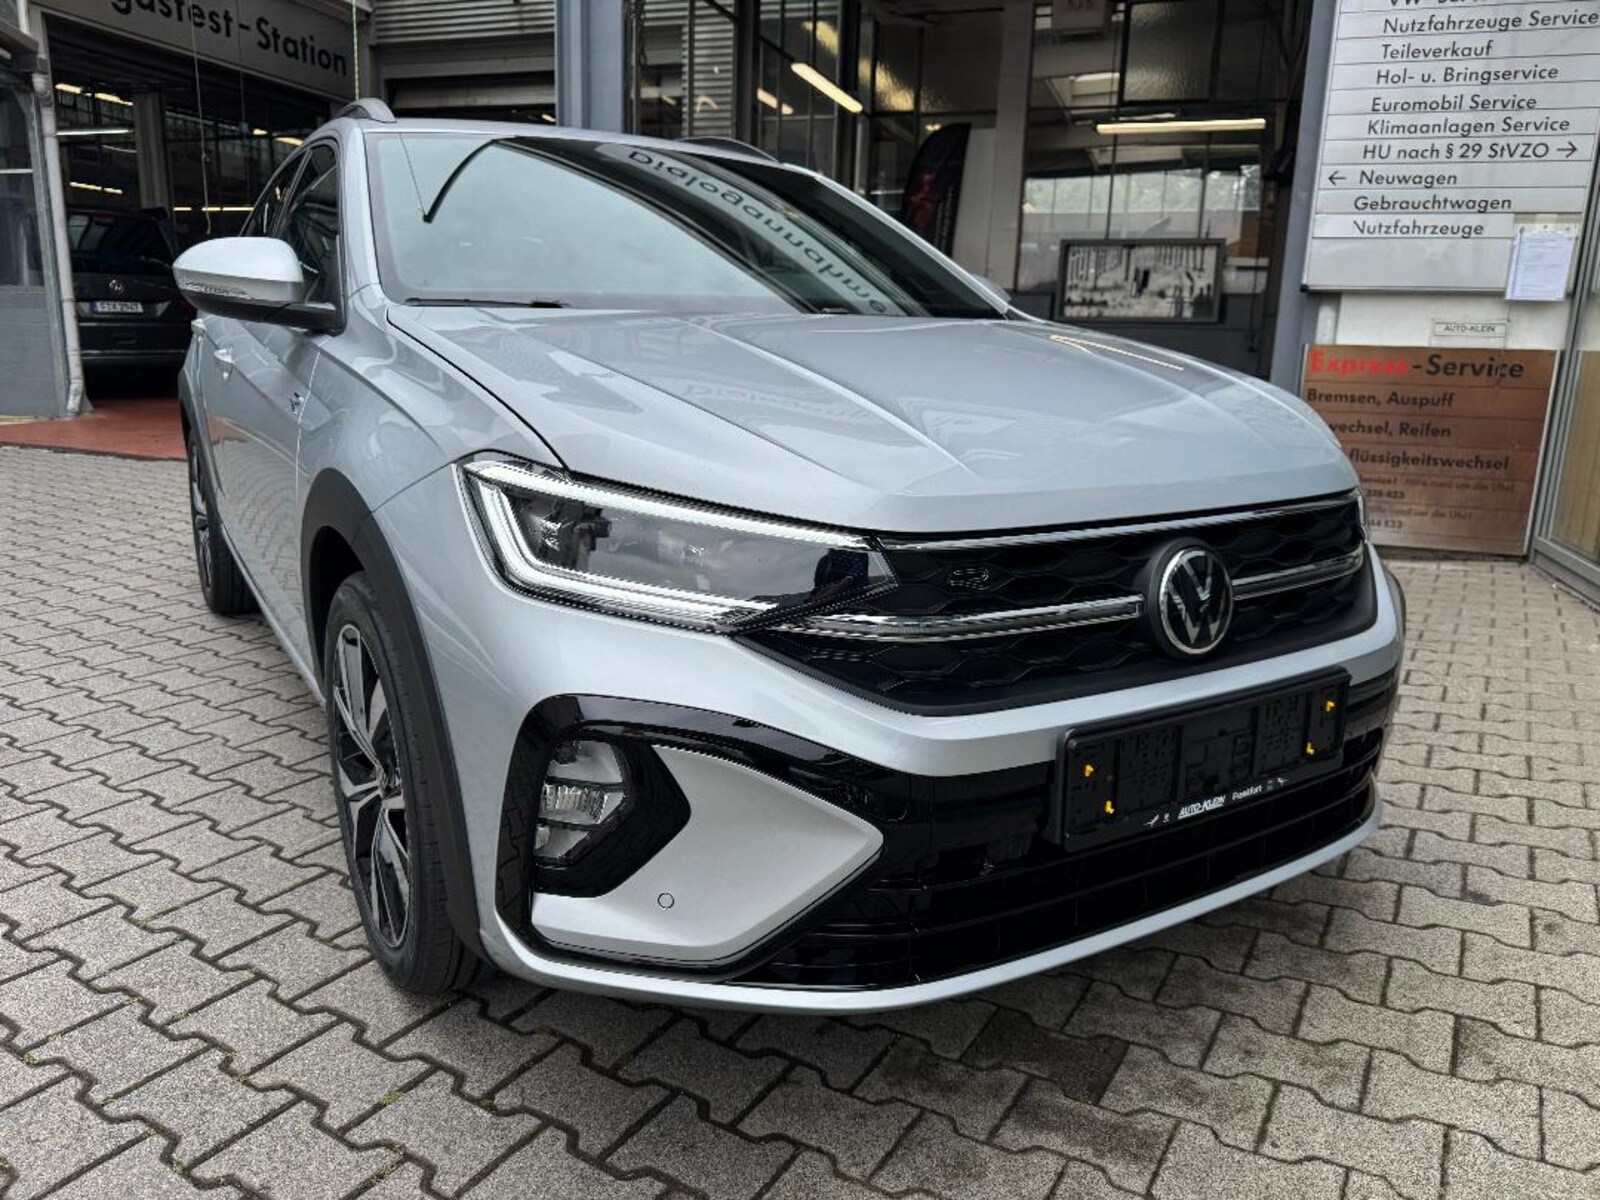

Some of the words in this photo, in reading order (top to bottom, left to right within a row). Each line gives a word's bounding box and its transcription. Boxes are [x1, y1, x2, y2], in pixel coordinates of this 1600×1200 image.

[1383, 13, 1522, 34] Nutzfahrzeuge
[1528, 10, 1599, 27] Service
[1382, 39, 1494, 60] Teileverkauf
[1376, 69, 1415, 84] Hol-
[1421, 72, 1436, 83] u.
[1443, 64, 1559, 85] Bringservice
[1371, 95, 1463, 112] Euromobil
[1469, 94, 1537, 110] Service
[1367, 118, 1495, 137] Klimaanlagen
[1501, 117, 1570, 132] Service
[1362, 145, 1391, 160] HU
[1397, 144, 1439, 160] nach
[1445, 143, 1454, 160] §
[1459, 143, 1482, 159] 29
[1488, 142, 1550, 158] StVZO
[1359, 170, 1457, 188] Neuwagen
[1353, 194, 1512, 213] Gebrauchtwagen
[1353, 218, 1484, 239] Nutzfahrzeuge
[1306, 388, 1382, 407] Bremsen,
[1386, 391, 1454, 410] Auspuff
[1399, 422, 1451, 438] Reifen
